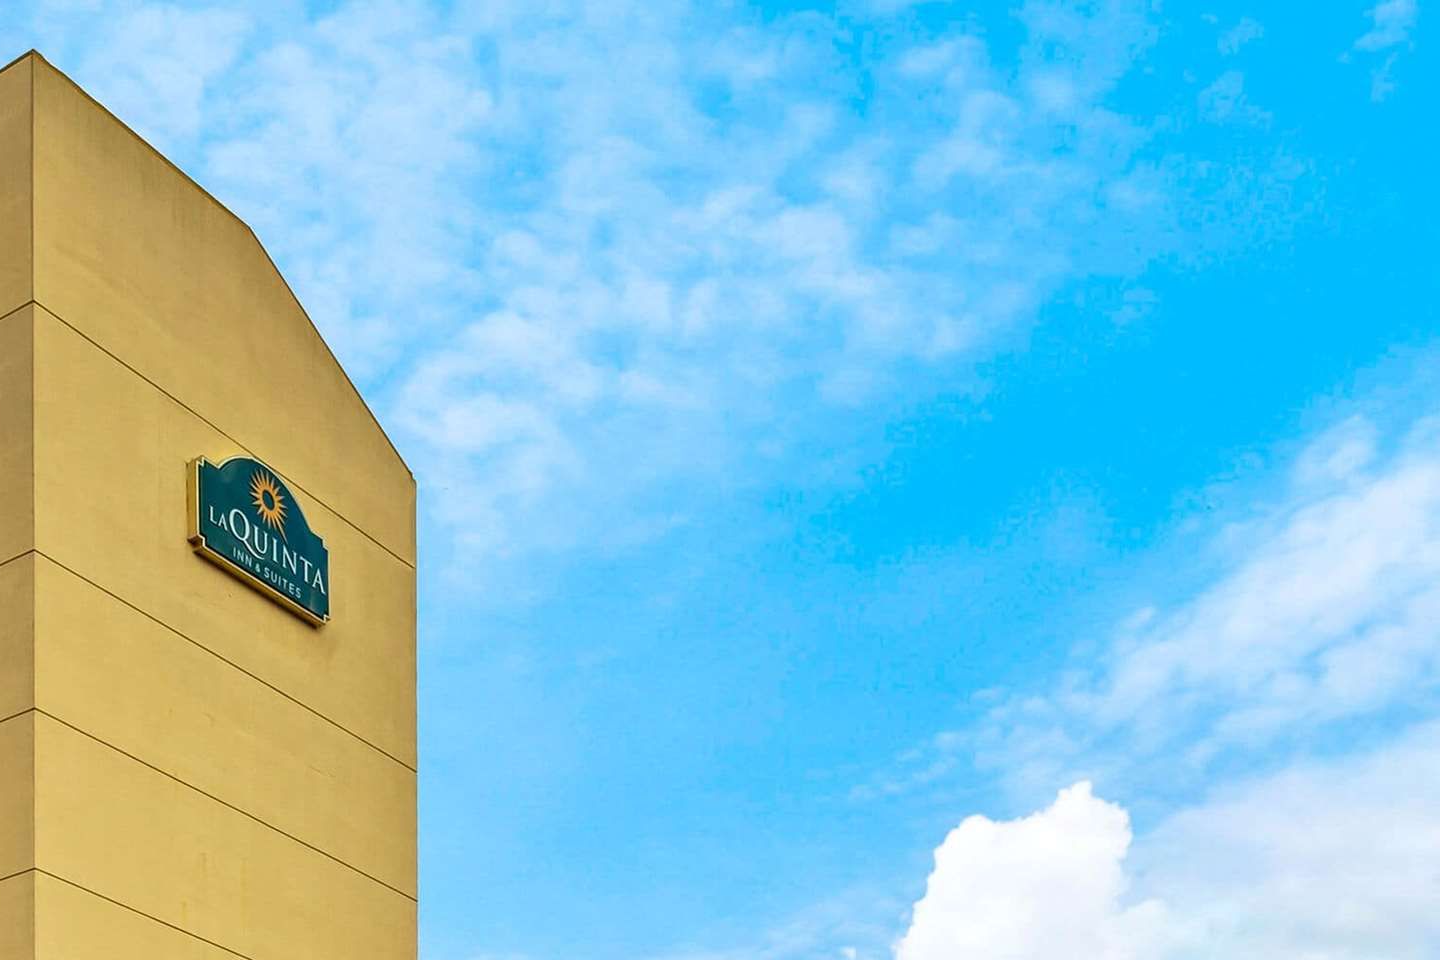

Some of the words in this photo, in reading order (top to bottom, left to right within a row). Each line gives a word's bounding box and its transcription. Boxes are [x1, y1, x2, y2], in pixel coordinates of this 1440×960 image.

[209, 505, 228, 531] LA
[229, 508, 326, 595] QUINTA
[233, 546, 252, 568] INN
[263, 567, 301, 599] SUITES
